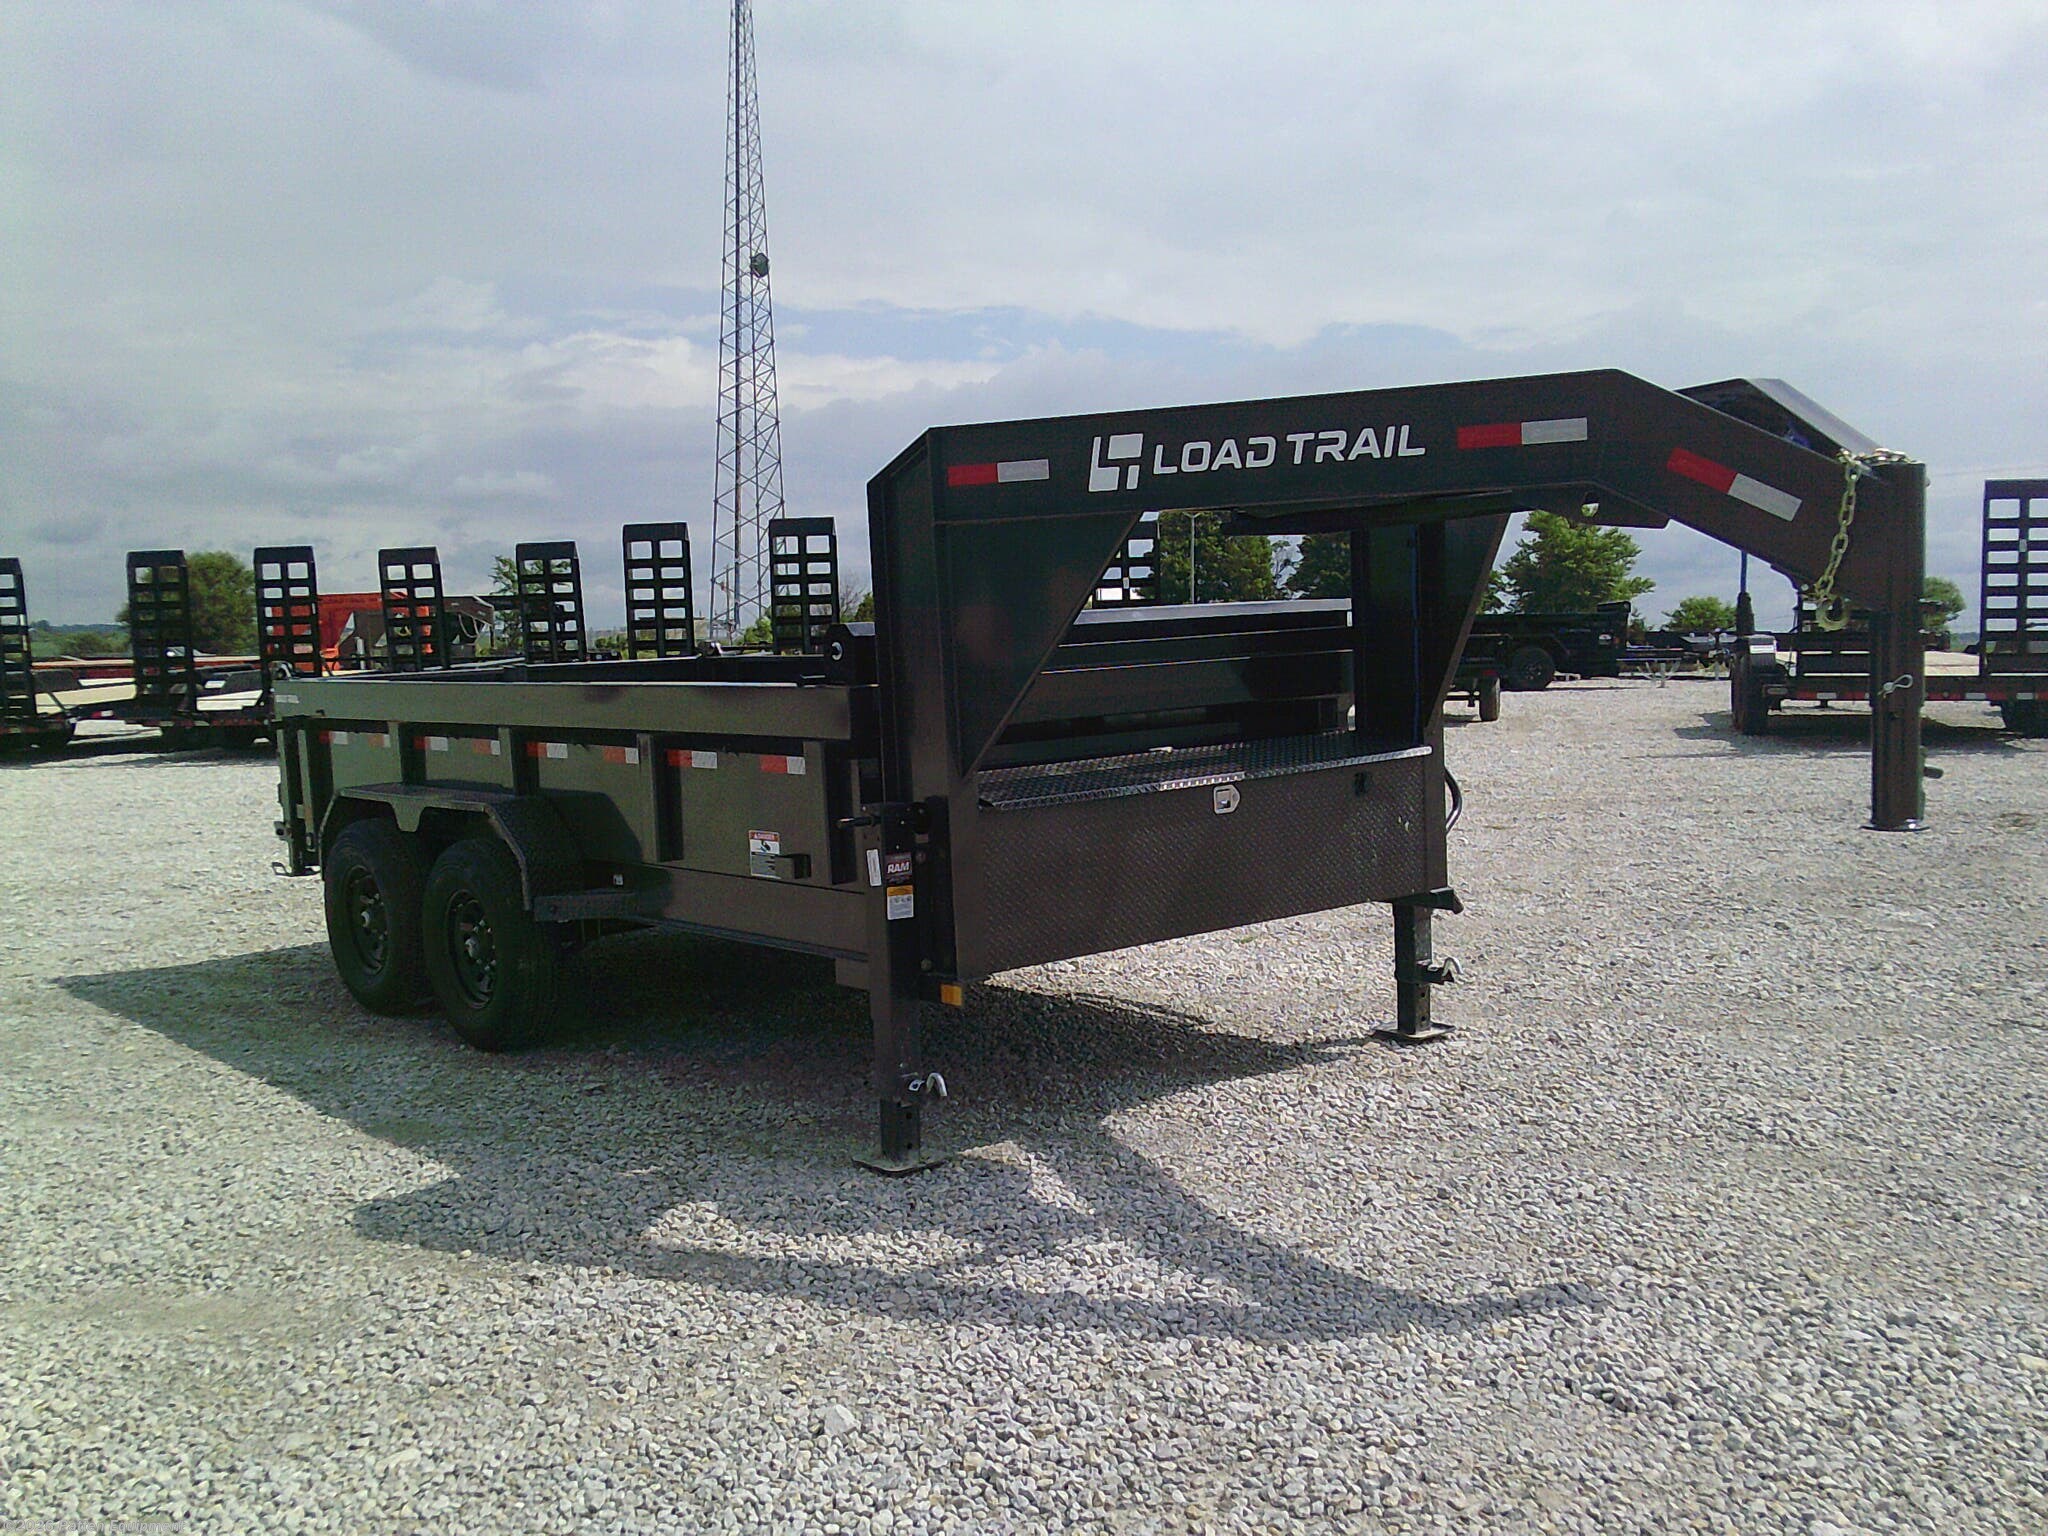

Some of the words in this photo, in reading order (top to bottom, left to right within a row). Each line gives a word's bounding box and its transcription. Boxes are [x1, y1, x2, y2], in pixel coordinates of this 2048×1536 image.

[1154, 437, 1276, 475] LOAD
[1287, 424, 1426, 465] TRAIL
[887, 862, 910, 874] RAM
